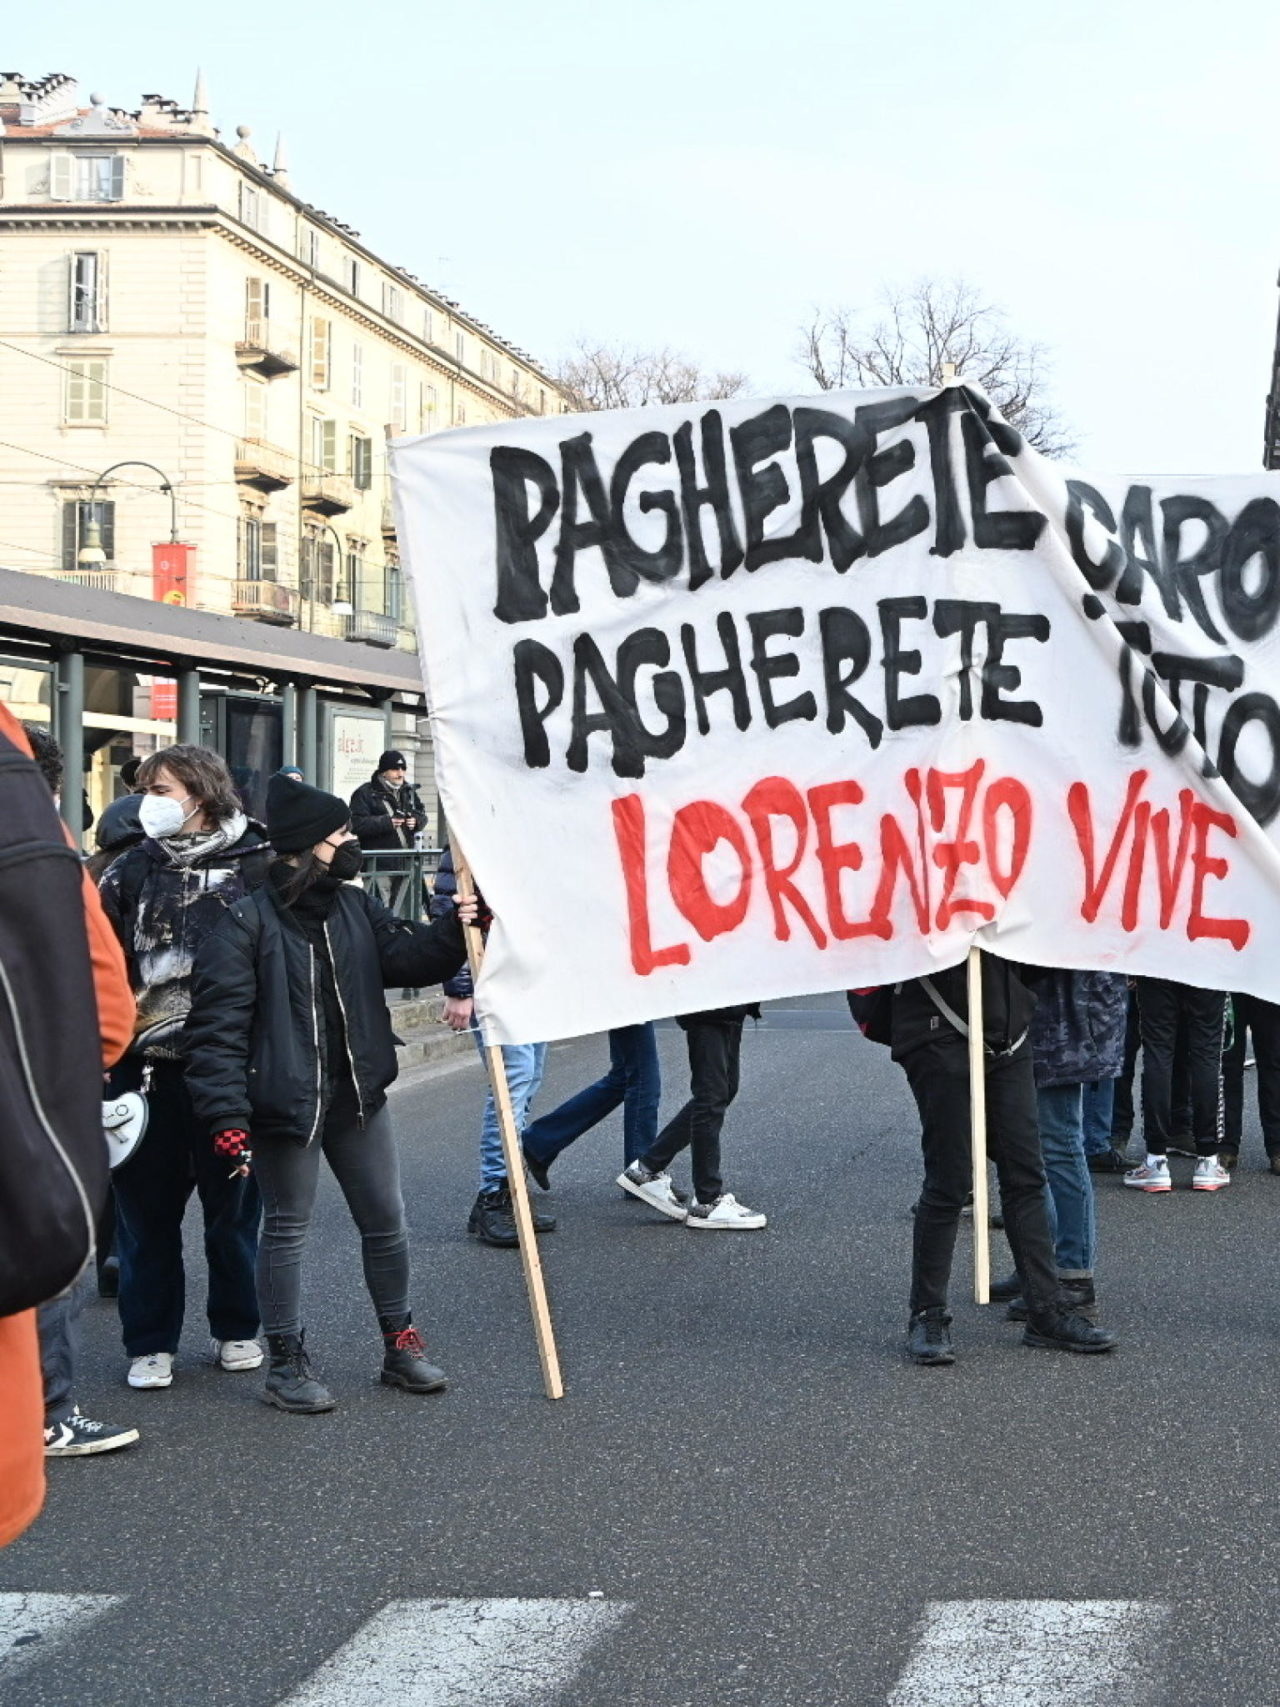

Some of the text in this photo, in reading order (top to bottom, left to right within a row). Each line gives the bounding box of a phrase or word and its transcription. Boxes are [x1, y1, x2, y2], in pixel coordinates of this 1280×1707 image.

[490, 386, 1048, 623] PAGHERETE
[514, 595, 1050, 778] PAGHERETE
[611, 757, 1252, 976] LORENZO VIVE
